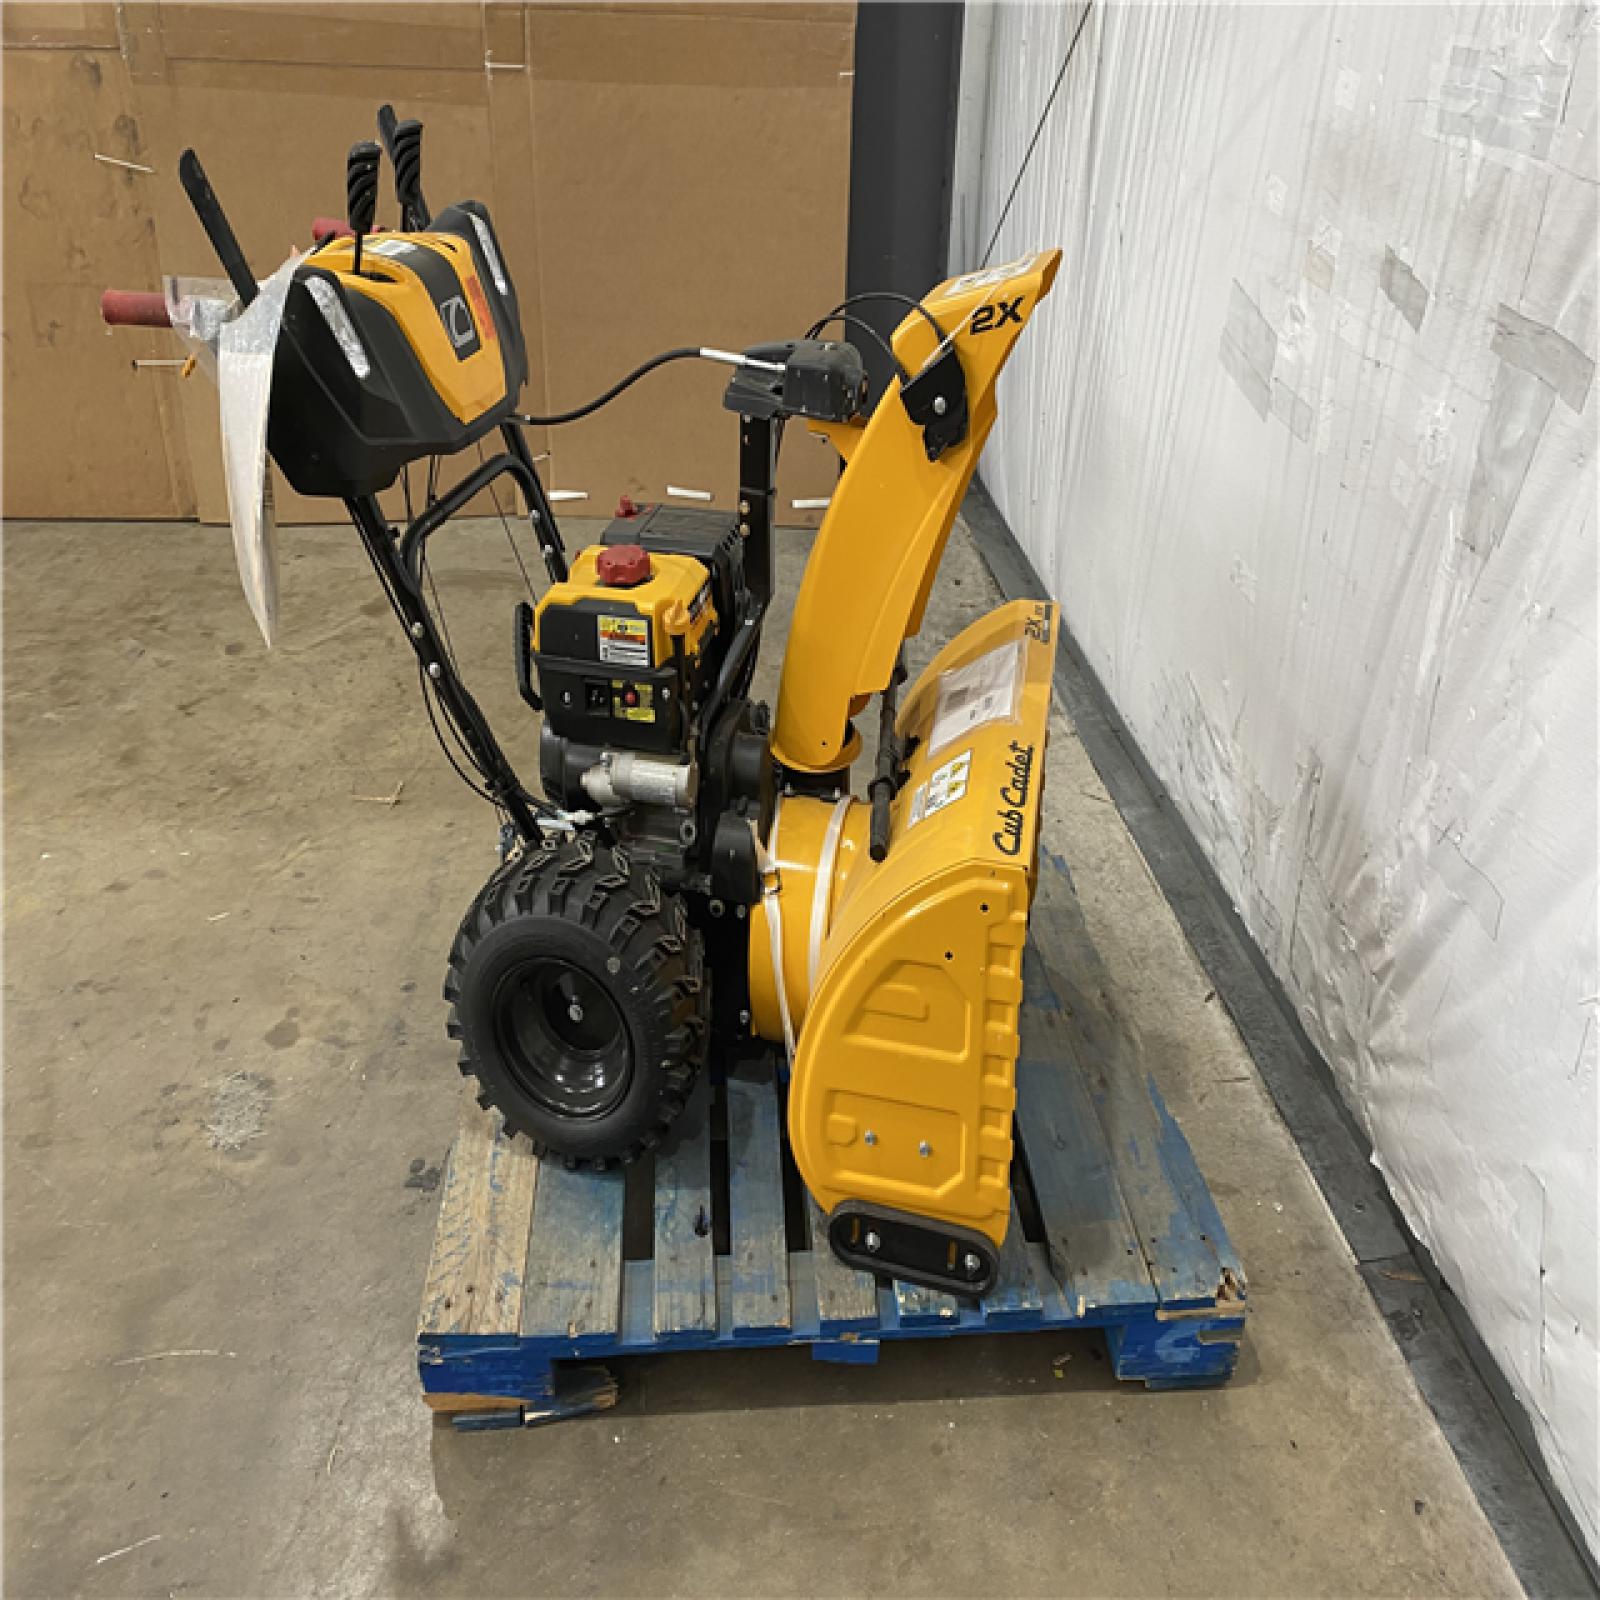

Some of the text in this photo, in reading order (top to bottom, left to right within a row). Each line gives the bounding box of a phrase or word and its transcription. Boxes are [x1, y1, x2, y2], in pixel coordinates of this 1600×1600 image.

[970, 295, 1025, 335] 2X
[992, 740, 1034, 855] Cub Cadet
